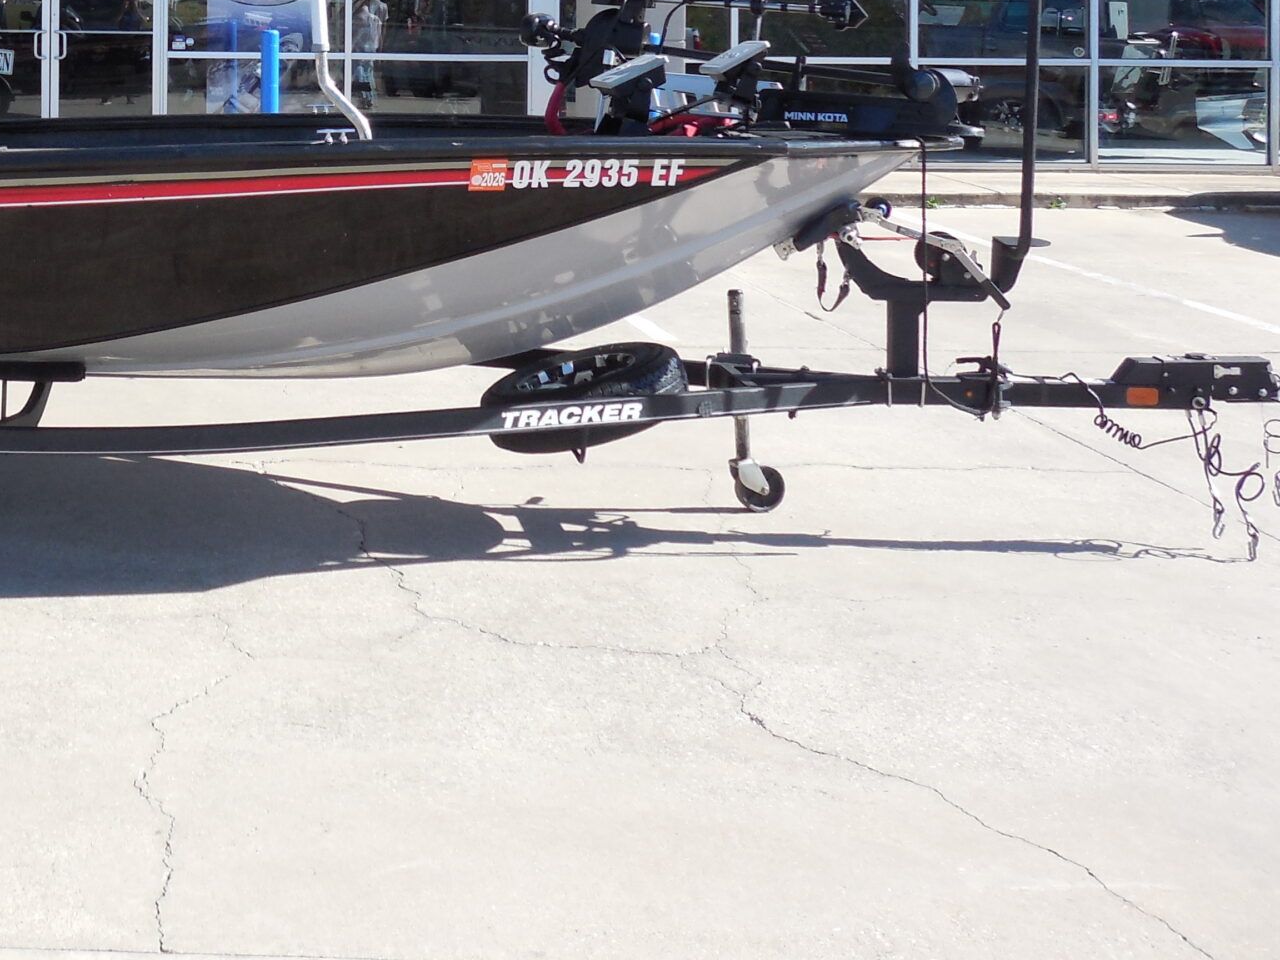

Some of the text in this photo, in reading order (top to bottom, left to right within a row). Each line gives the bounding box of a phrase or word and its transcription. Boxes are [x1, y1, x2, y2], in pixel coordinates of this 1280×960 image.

[784, 111, 849, 123] MINN KOTA
[480, 172, 505, 187] 2026
[511, 158, 686, 189] OK 2935 EF
[501, 402, 644, 429] TRACKER
